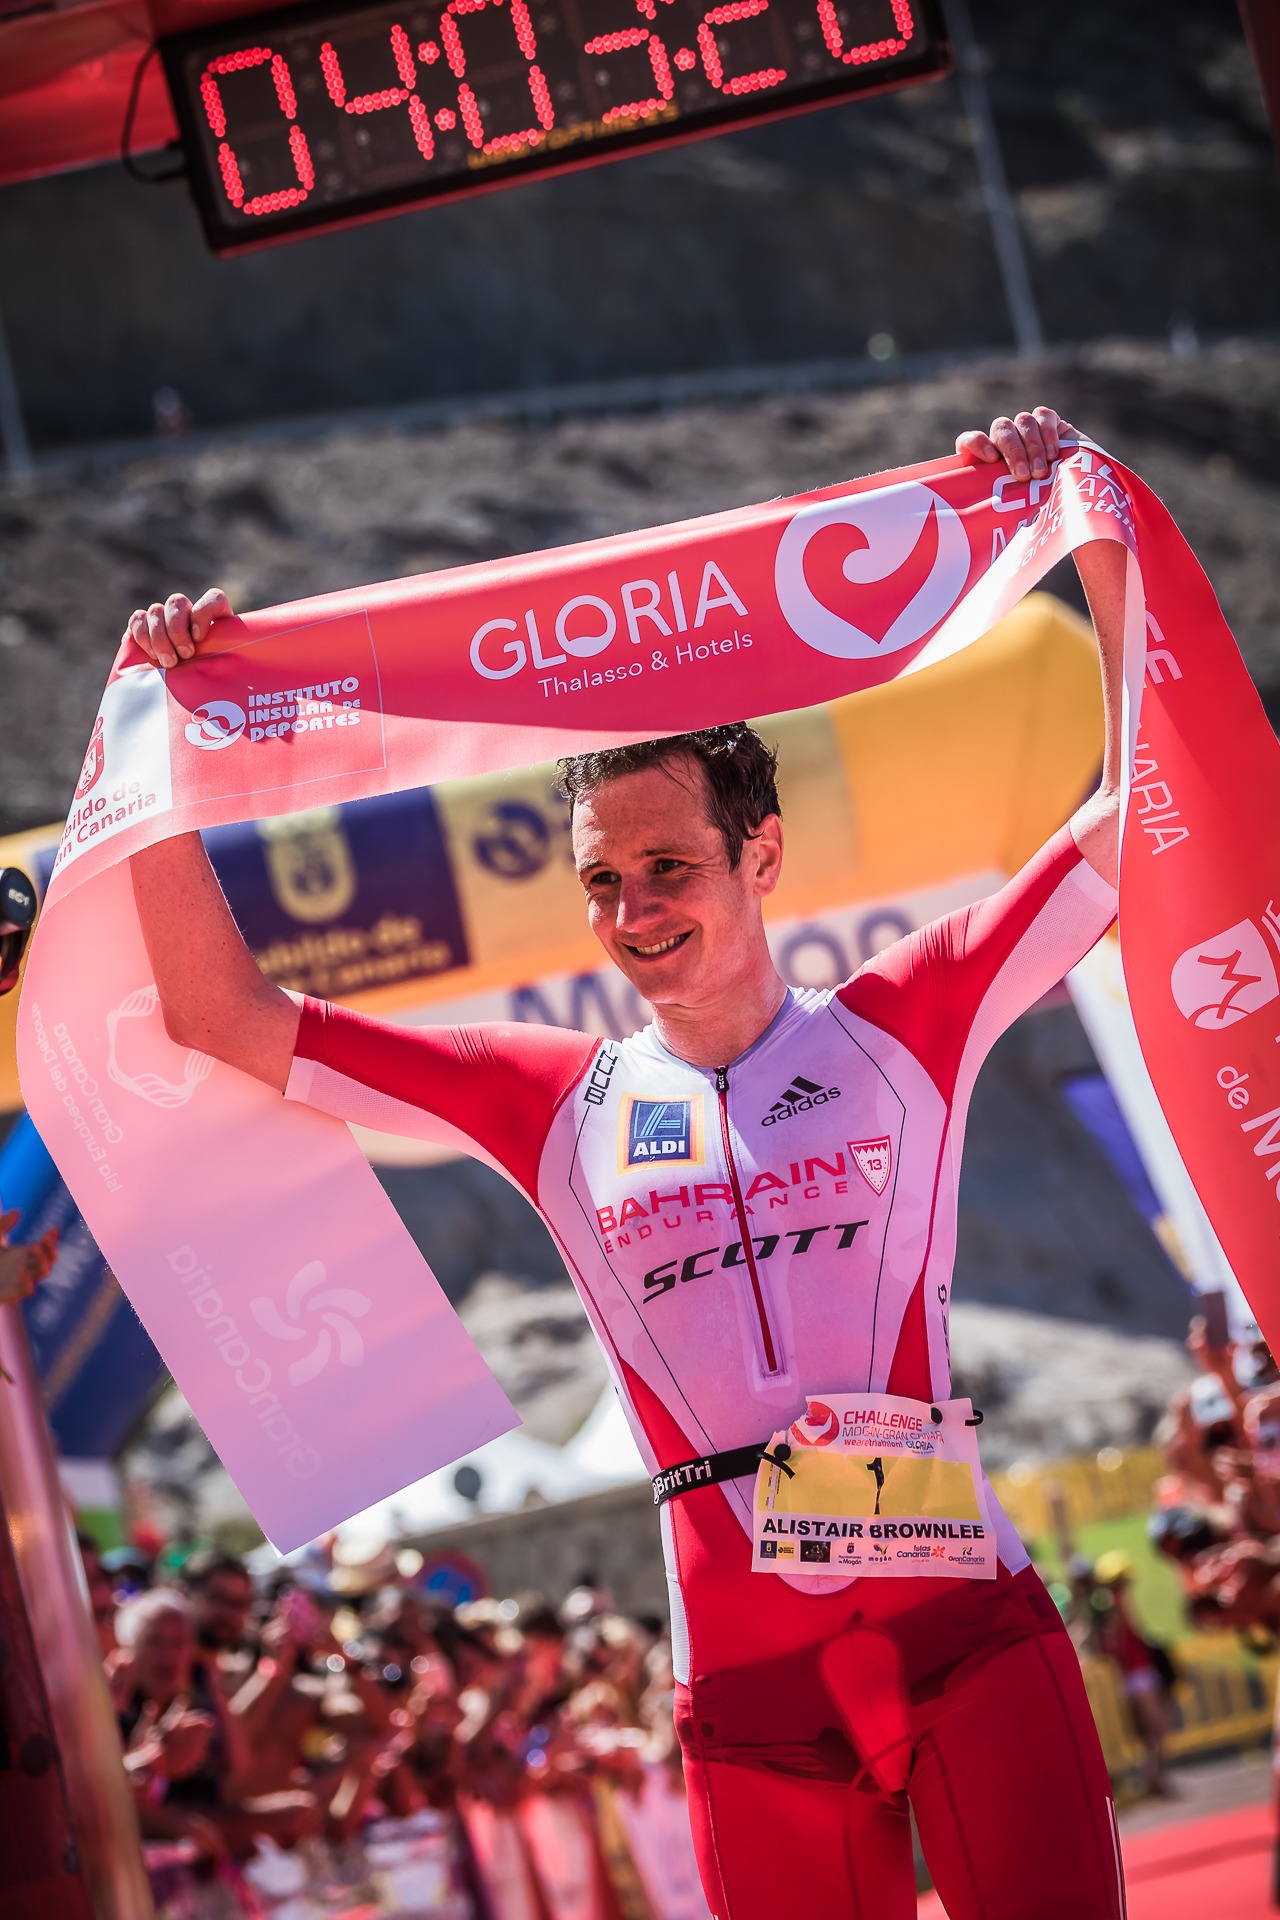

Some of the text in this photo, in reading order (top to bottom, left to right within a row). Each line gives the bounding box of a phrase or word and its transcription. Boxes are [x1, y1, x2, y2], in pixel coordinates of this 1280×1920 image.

[469, 560, 749, 681] GLORIA
[538, 630, 754, 699] Thalasso & Hotels
[248, 676, 360, 708] INSTITUTO
[248, 698, 361, 724] INSULAR DE
[250, 711, 362, 743] DEPORTES
[112, 781, 141, 802] de
[76, 793, 157, 843] Canaria
[1216, 1065, 1250, 1110] de
[760, 1083, 842, 1128] adidas
[632, 1139, 687, 1158] ALDI
[866, 1158, 883, 1173] 13
[596, 1151, 846, 1235] BAHRAIN
[603, 1180, 850, 1254] ENDURANCE
[642, 1219, 870, 1306] SCOTT
[843, 1410, 923, 1432] CHALLENGE
[905, 1440, 934, 1450] GLORIA
[866, 1457, 885, 1515] 1
[762, 1518, 985, 1540] ALISTAIR BROWNLEE
[896, 1550, 931, 1558] Canarias
